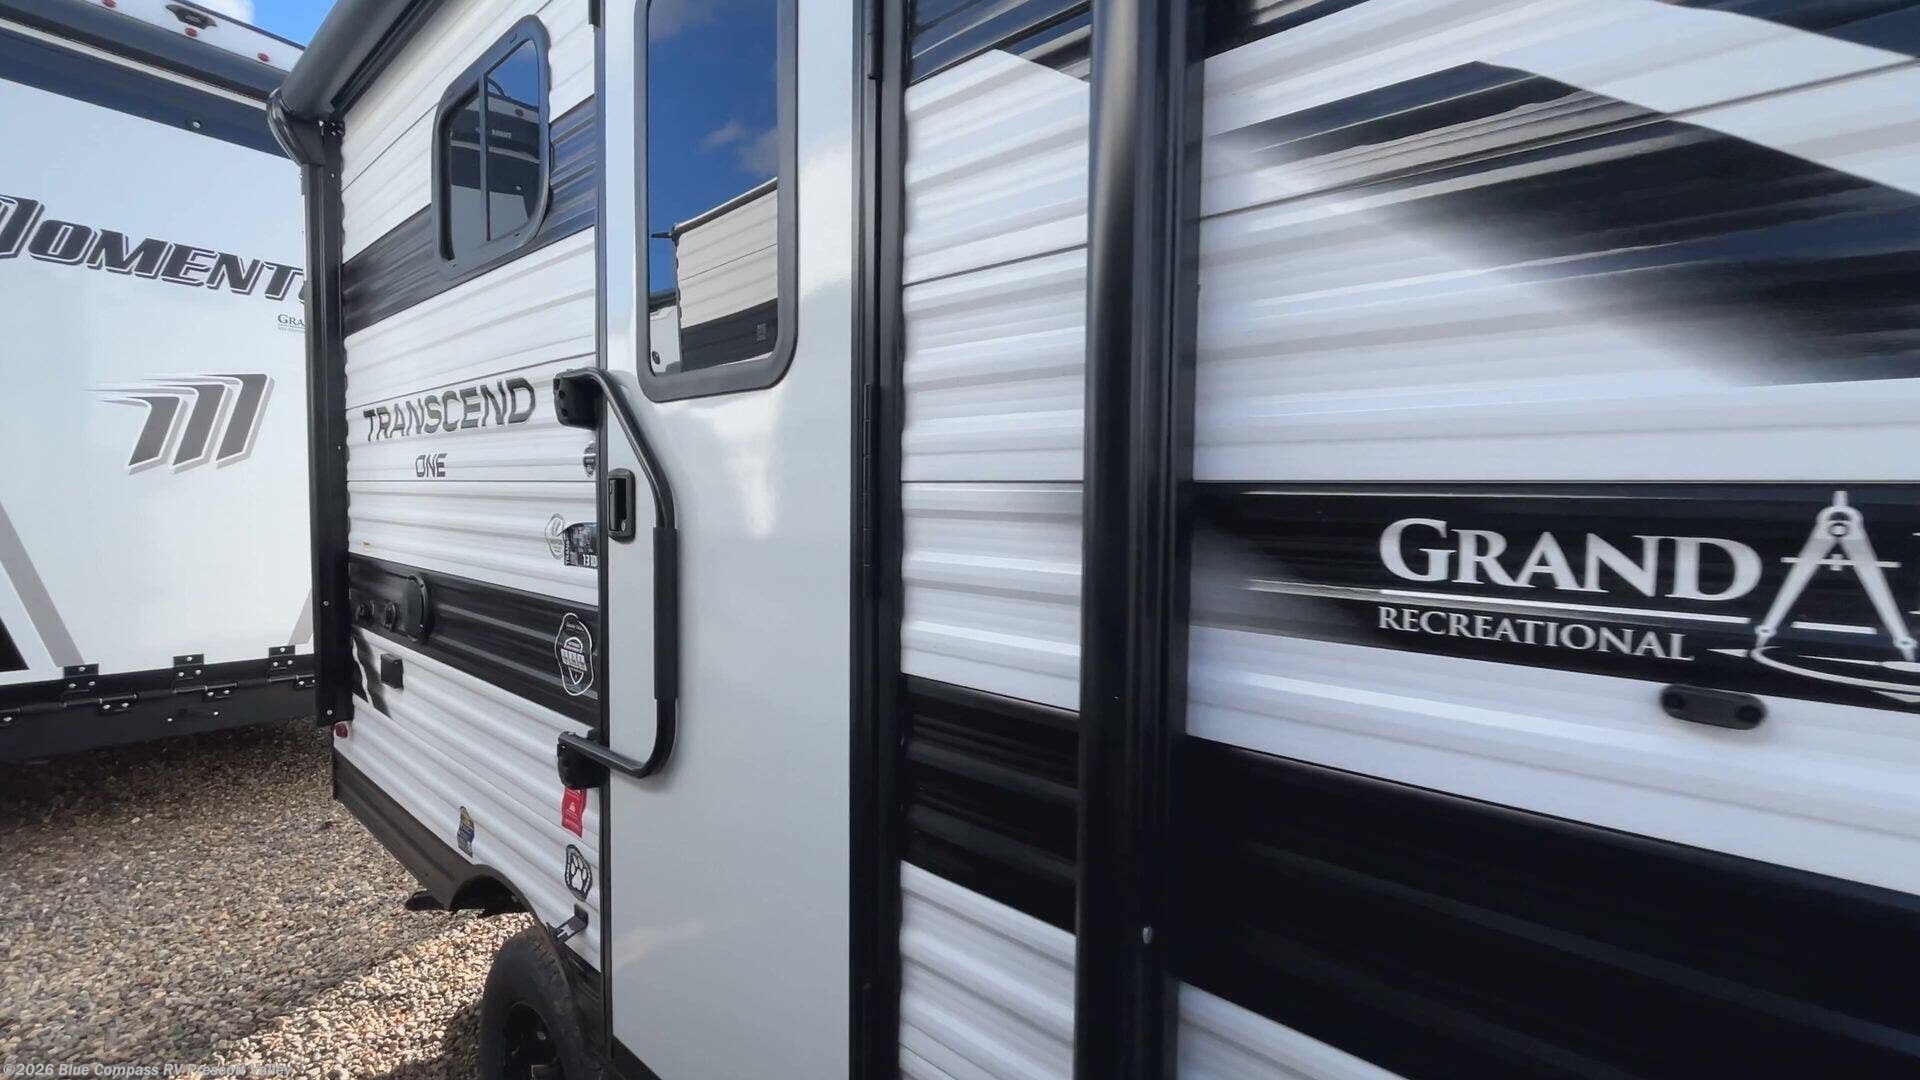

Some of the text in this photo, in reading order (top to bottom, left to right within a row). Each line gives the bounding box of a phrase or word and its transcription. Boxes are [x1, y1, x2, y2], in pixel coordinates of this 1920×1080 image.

[0, 194, 304, 304] OMENT
[277, 313, 305, 326] GRA
[363, 377, 536, 442] TRANSCEND
[415, 453, 447, 477] ONE
[1379, 517, 1763, 601] GRAND
[1378, 606, 1695, 662] RECREATIONAL
